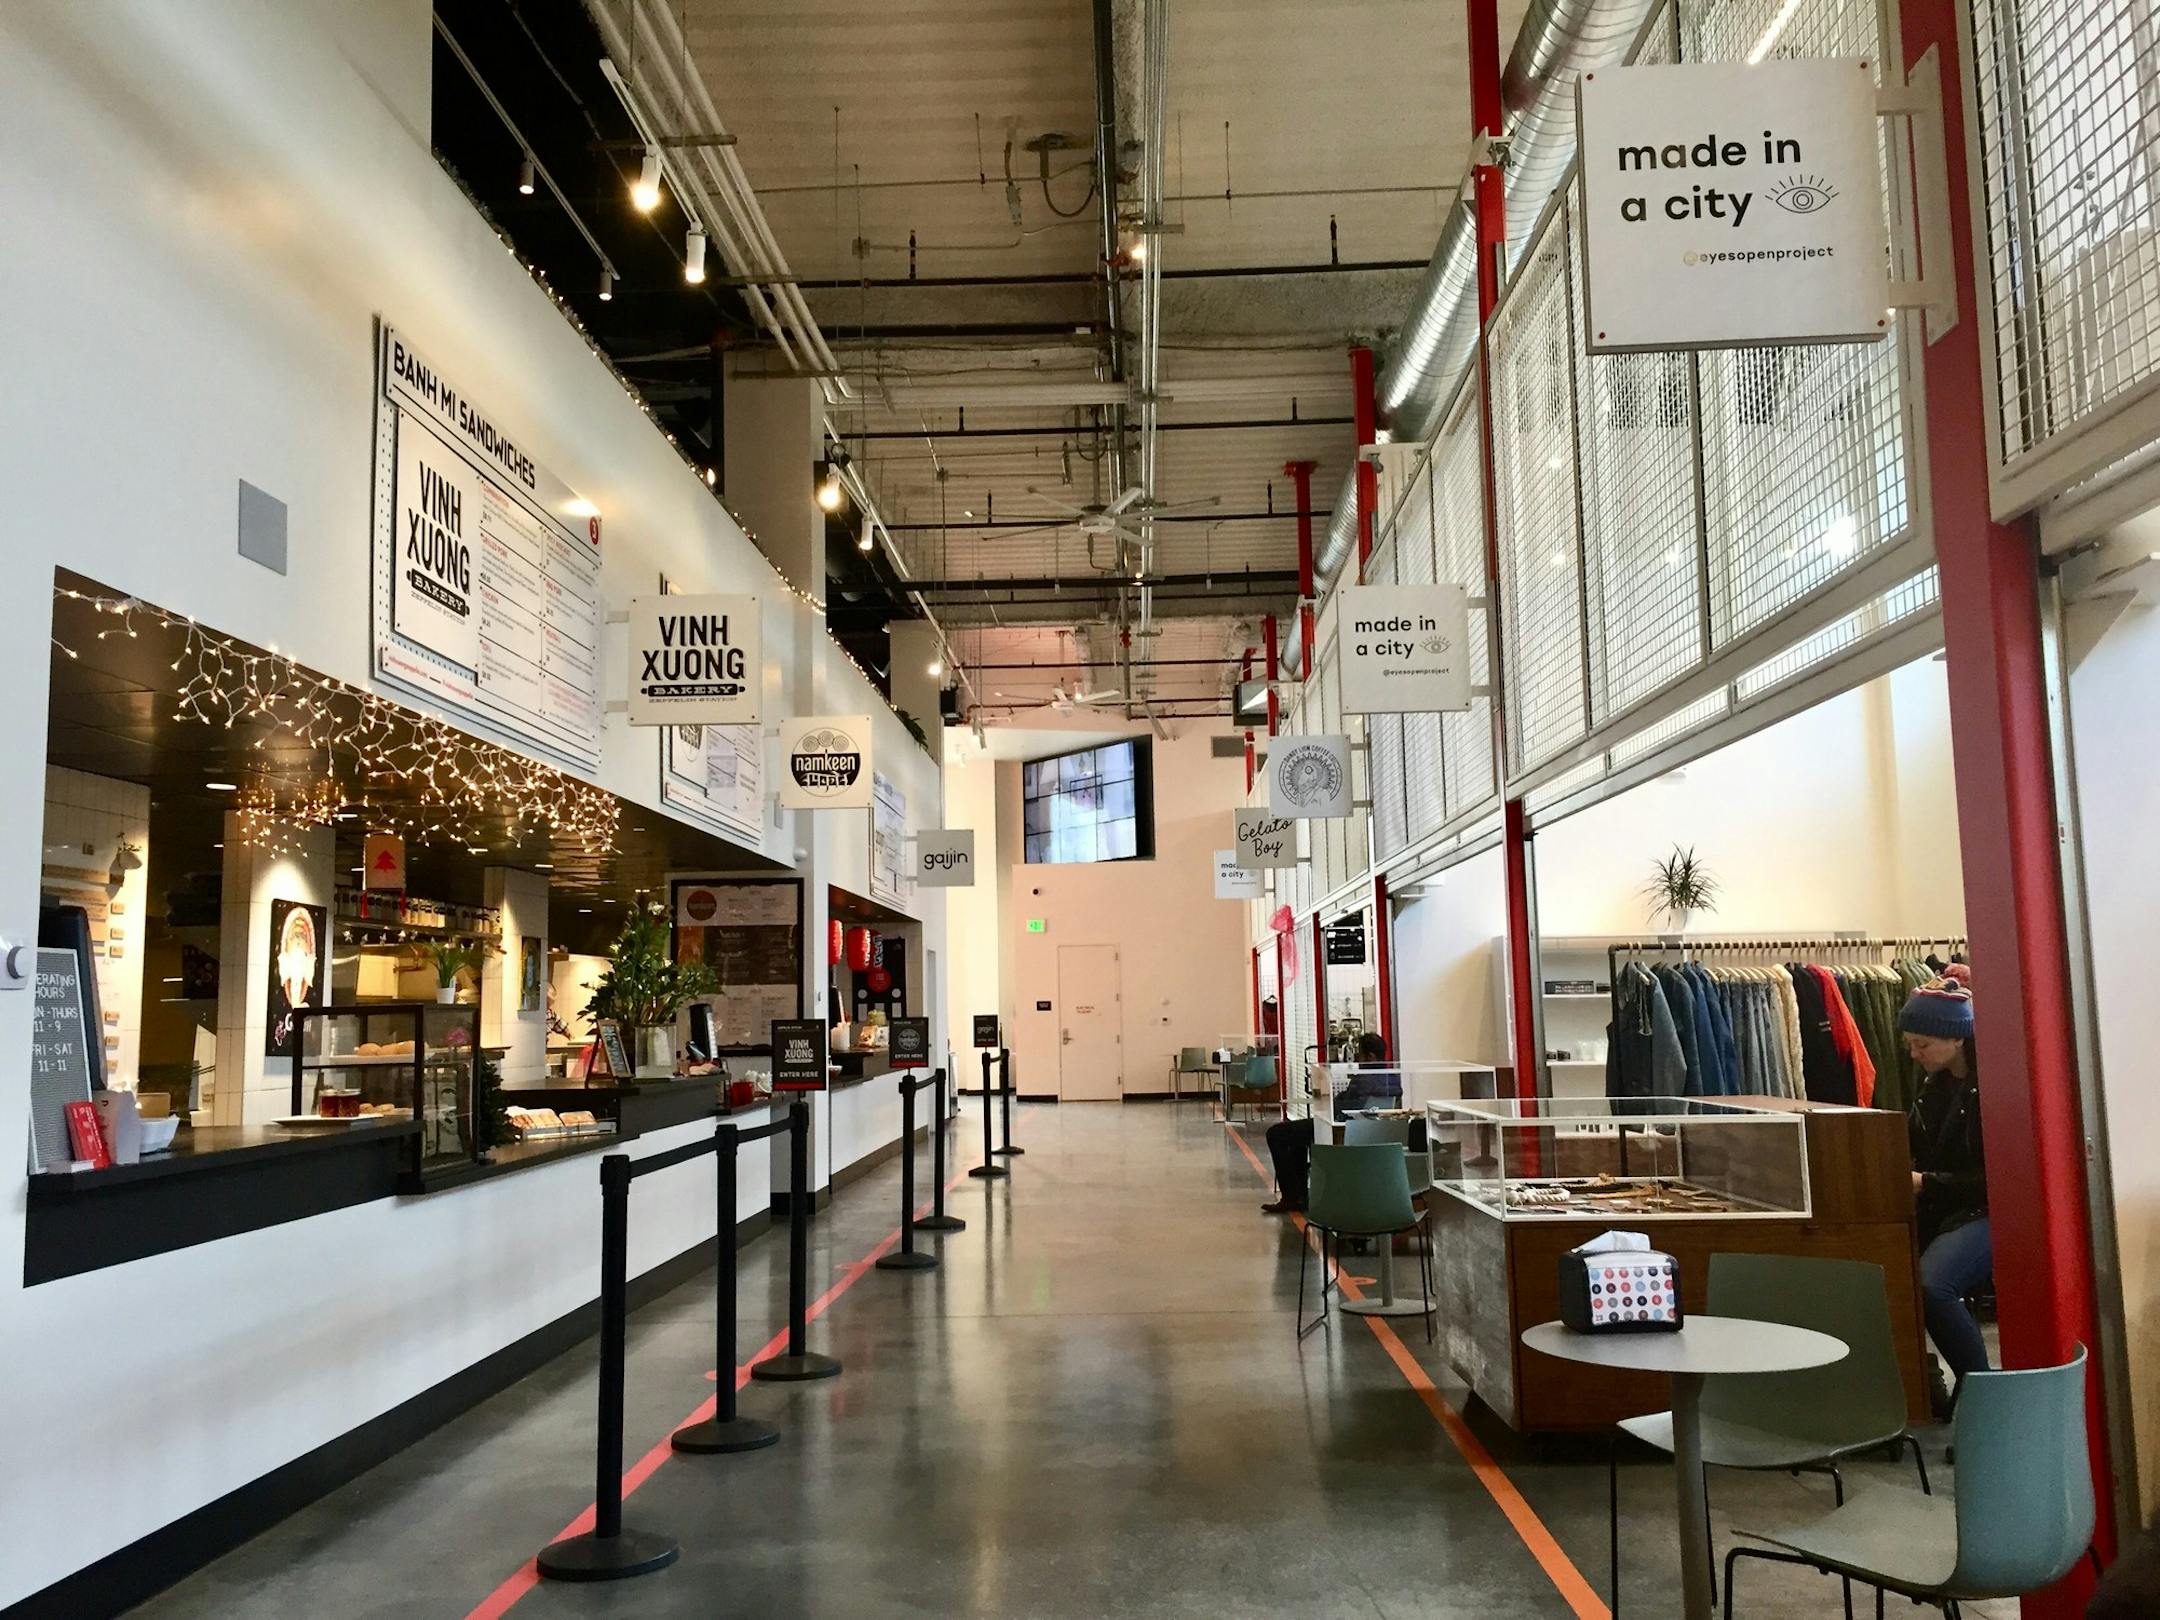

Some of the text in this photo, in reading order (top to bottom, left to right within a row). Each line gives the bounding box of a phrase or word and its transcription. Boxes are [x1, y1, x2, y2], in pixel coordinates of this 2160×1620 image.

[1618, 130, 1801, 171] made in
[1620, 185, 1753, 227] a city
[1683, 246, 1834, 266] @eyesopenproject
[394, 342, 536, 490] BANH MI SANDWICHES
[420, 461, 462, 539] VINH
[407, 508, 471, 597] XUONG
[414, 575, 464, 611] BAKERY
[659, 615, 728, 647] VINH
[1355, 616, 1436, 633] made in
[1356, 639, 1415, 659] a city
[641, 648, 746, 681] XUONG
[654, 686, 734, 695] BAKERY
[796, 749, 856, 772] namkeen
[1238, 818, 1293, 842] Gelato
[923, 847, 968, 870] gaijin
[1252, 838, 1283, 858] Boy
[1228, 870, 1244, 879] city
[36, 973, 75, 987] ERATING
[784, 1048, 814, 1058] XUONG
[788, 1039, 809, 1049] VINH
